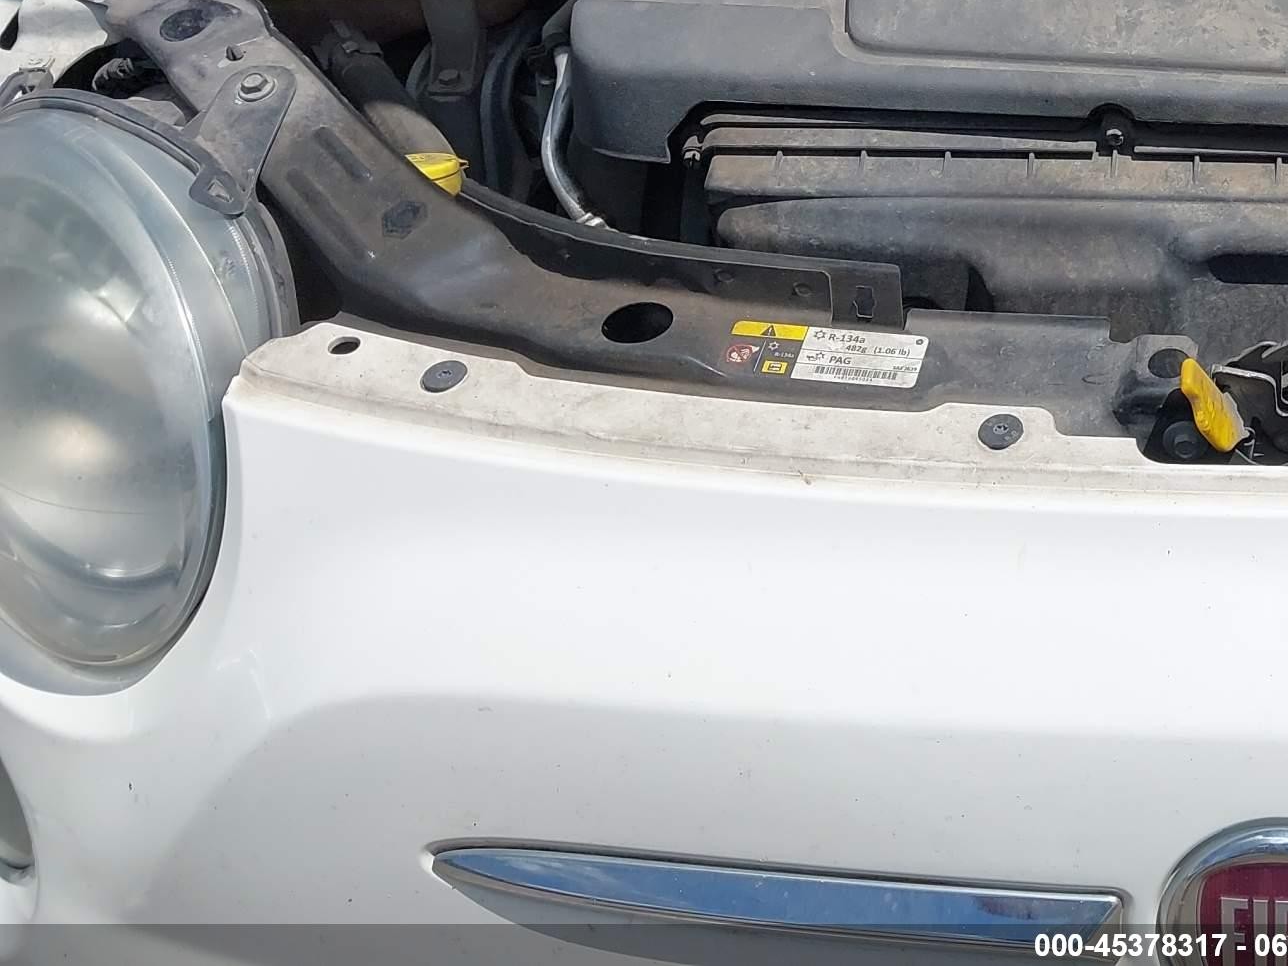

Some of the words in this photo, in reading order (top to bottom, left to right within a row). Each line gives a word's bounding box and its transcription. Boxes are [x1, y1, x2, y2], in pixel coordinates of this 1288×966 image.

[828, 333, 866, 344] R-134a
[845, 345, 868, 354] 482g
[873, 346, 896, 356] (1.06
[898, 348, 911, 357] lb)
[828, 355, 852, 366] PAG
